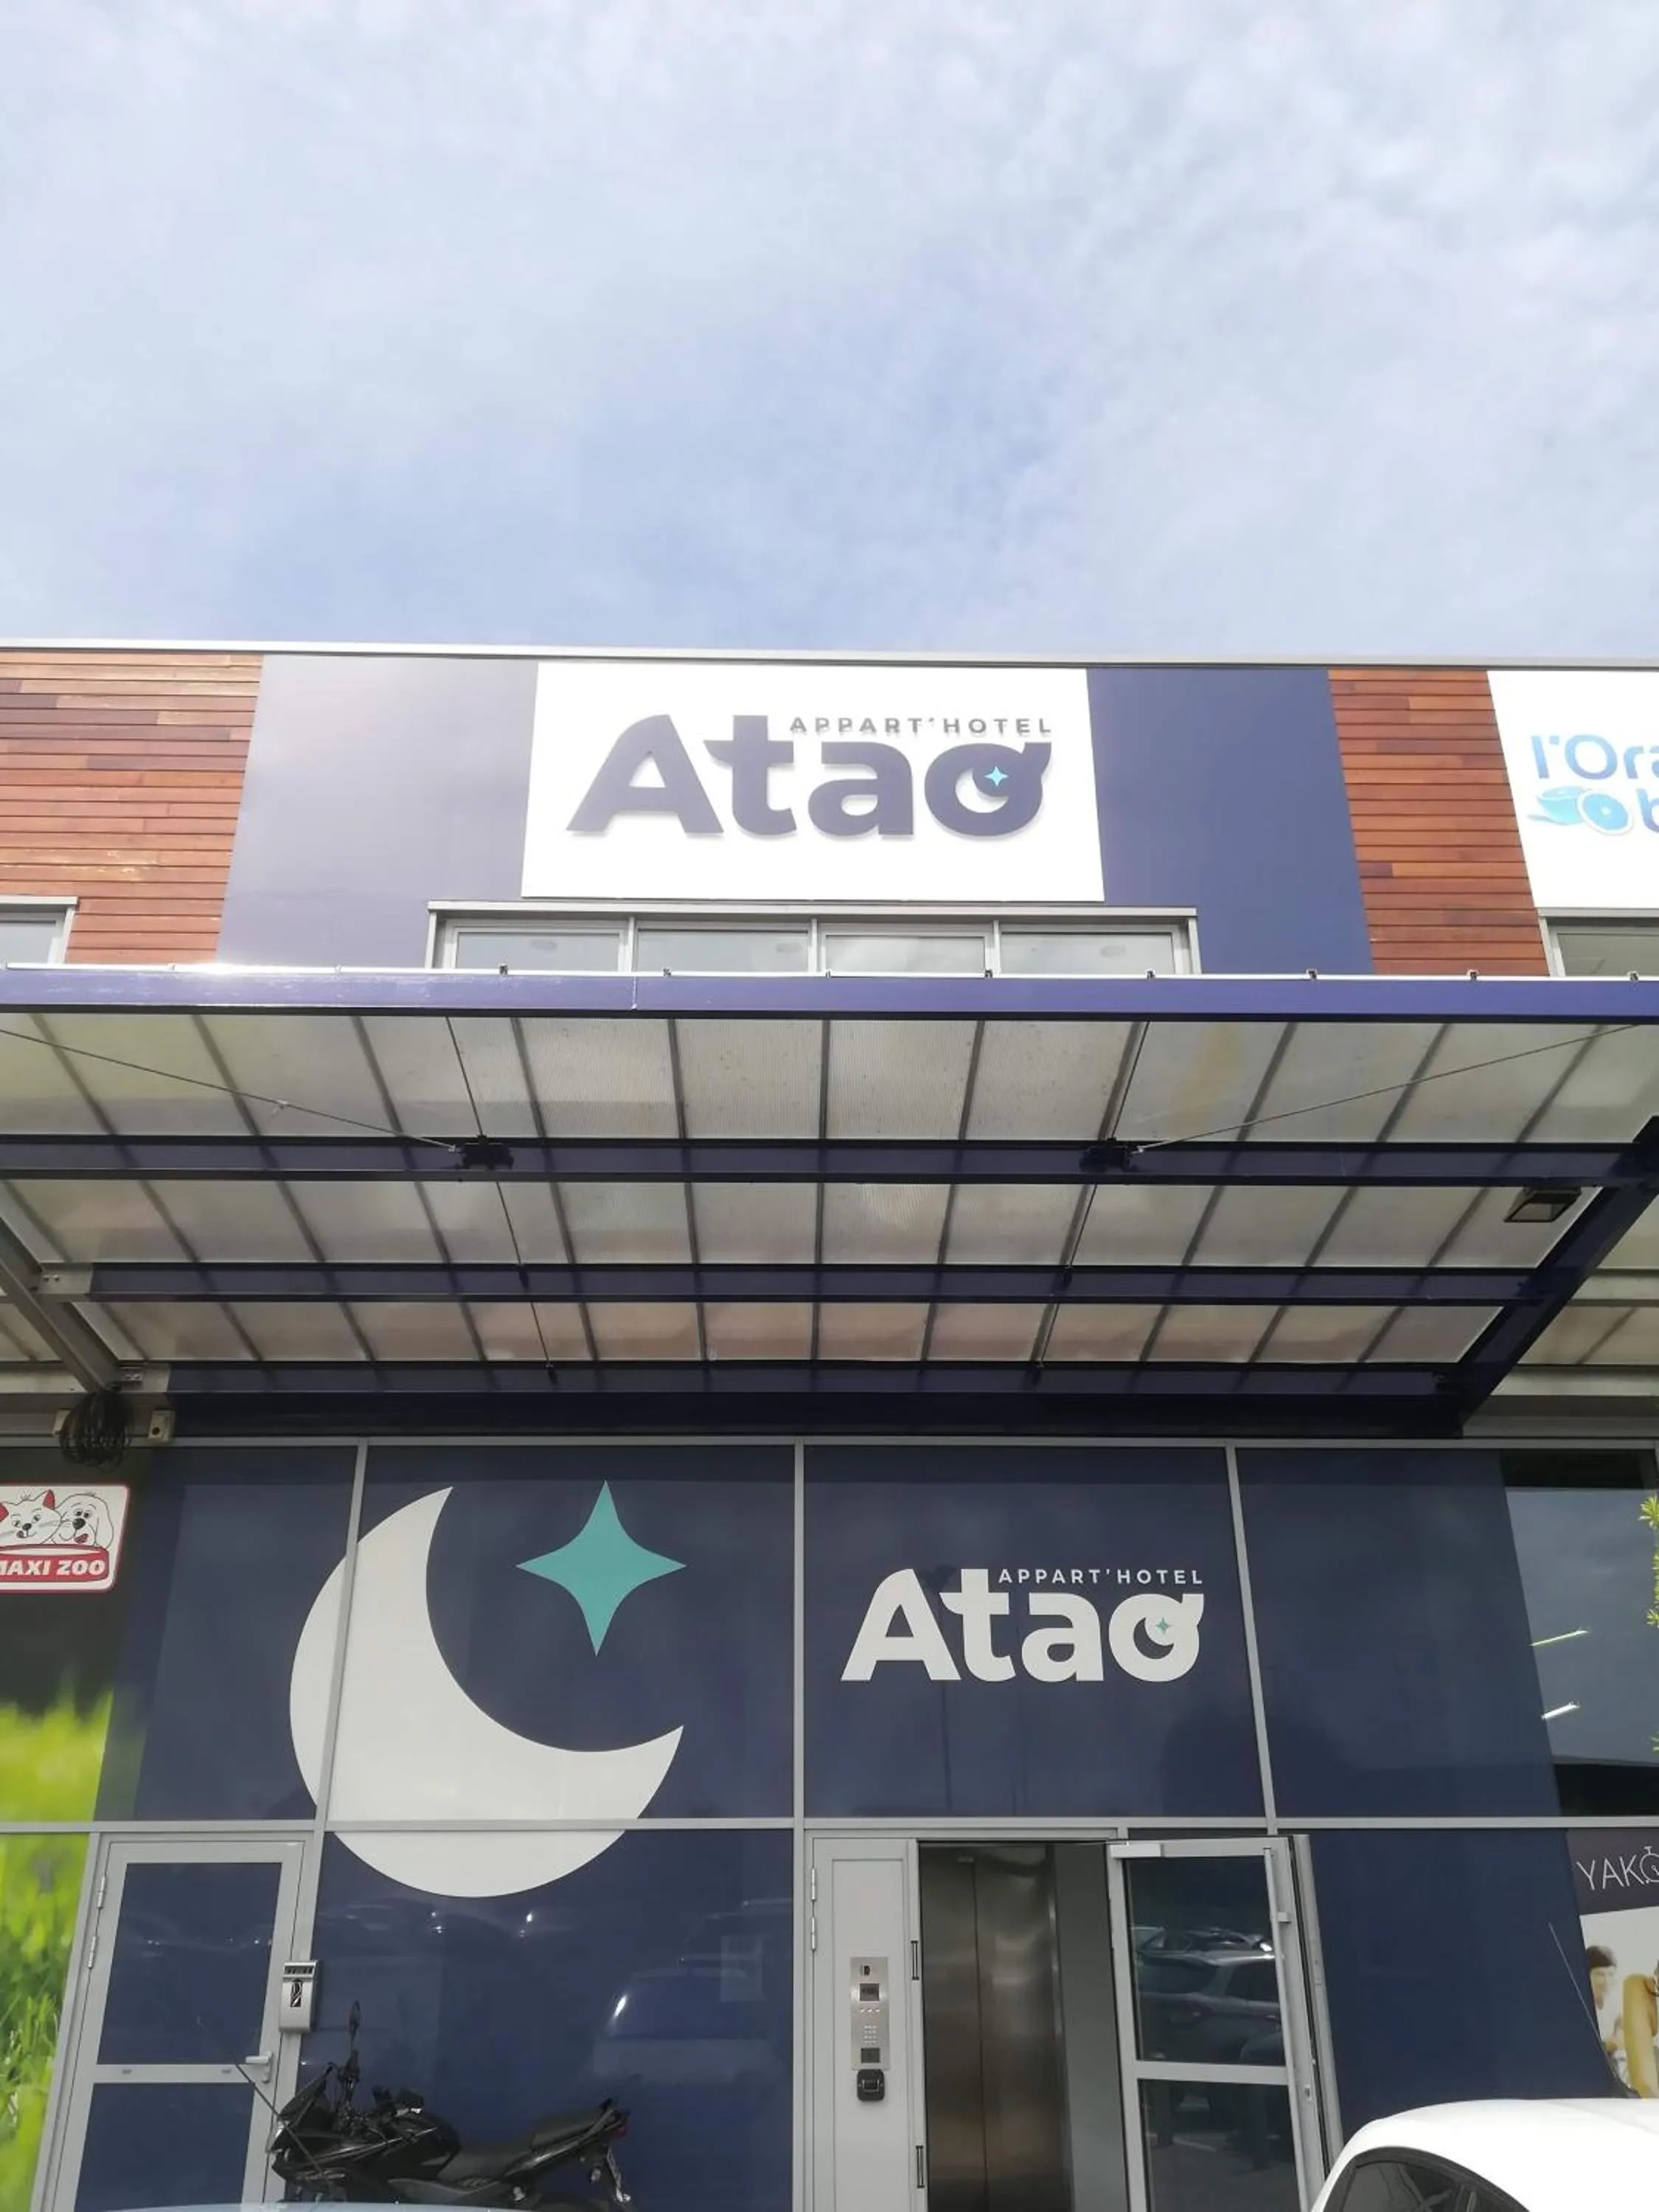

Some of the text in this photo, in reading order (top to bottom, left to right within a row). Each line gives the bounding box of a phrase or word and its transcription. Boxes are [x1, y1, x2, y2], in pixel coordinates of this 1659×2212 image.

[790, 717, 1051, 734] APPART'HOTEL
[566, 714, 1052, 836] Atao
[57, 1559, 105, 1576] ZOO
[998, 1568, 1203, 1585] APPART'HOTEL
[841, 1568, 1205, 1682] Atao
